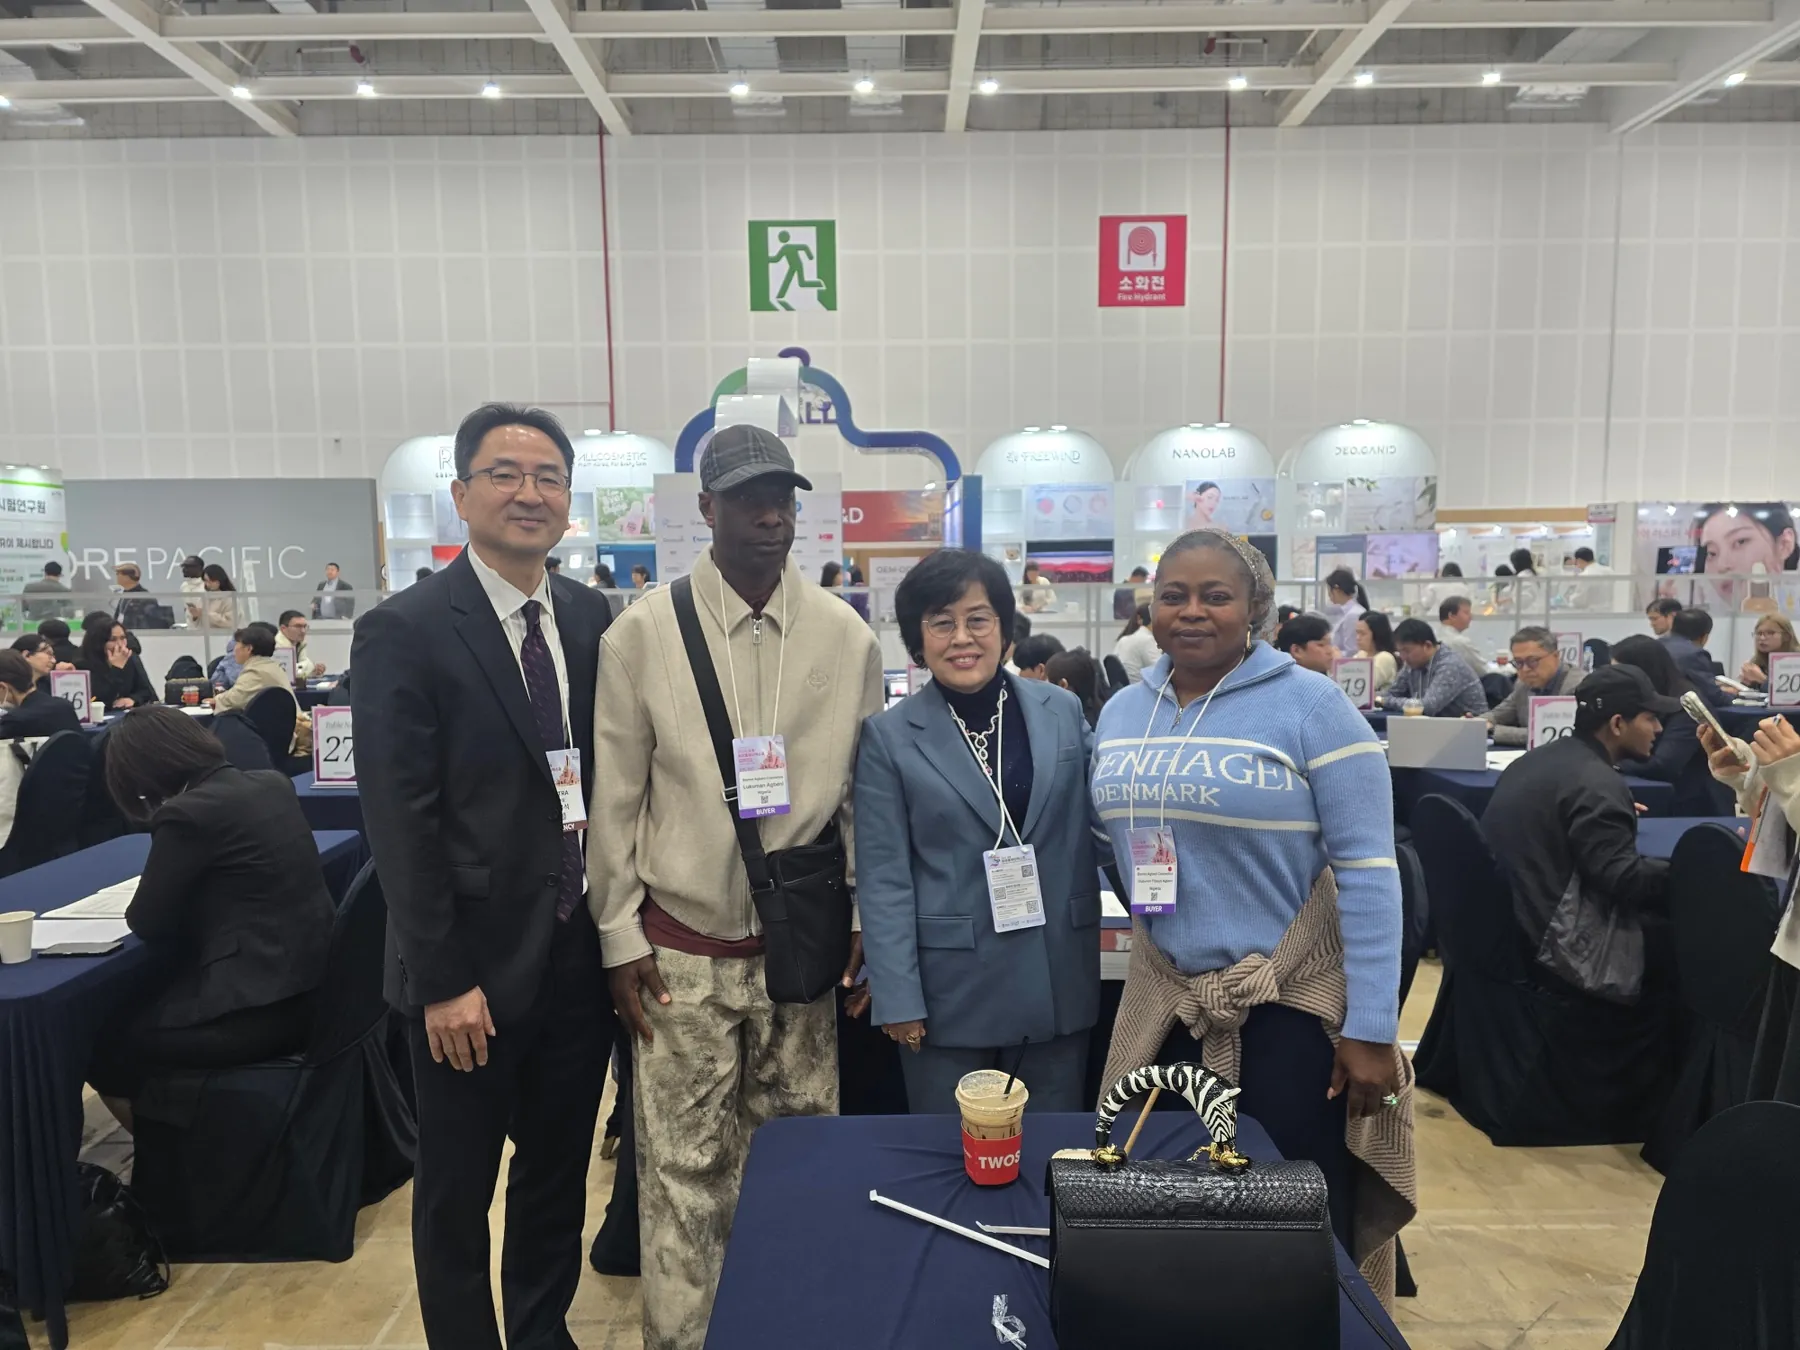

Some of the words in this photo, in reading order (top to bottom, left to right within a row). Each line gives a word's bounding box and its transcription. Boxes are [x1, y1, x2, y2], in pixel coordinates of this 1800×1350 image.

[1118, 275, 1165, 290] 소화전
[1118, 293, 1133, 301] Fire
[1172, 447, 1236, 459] NANOLAB
[1342, 678, 1366, 697] 19
[1776, 673, 1800, 693] 20
[323, 736, 353, 762] 27
[1095, 783, 1221, 807] DENMARK
[756, 807, 776, 816] BUYER
